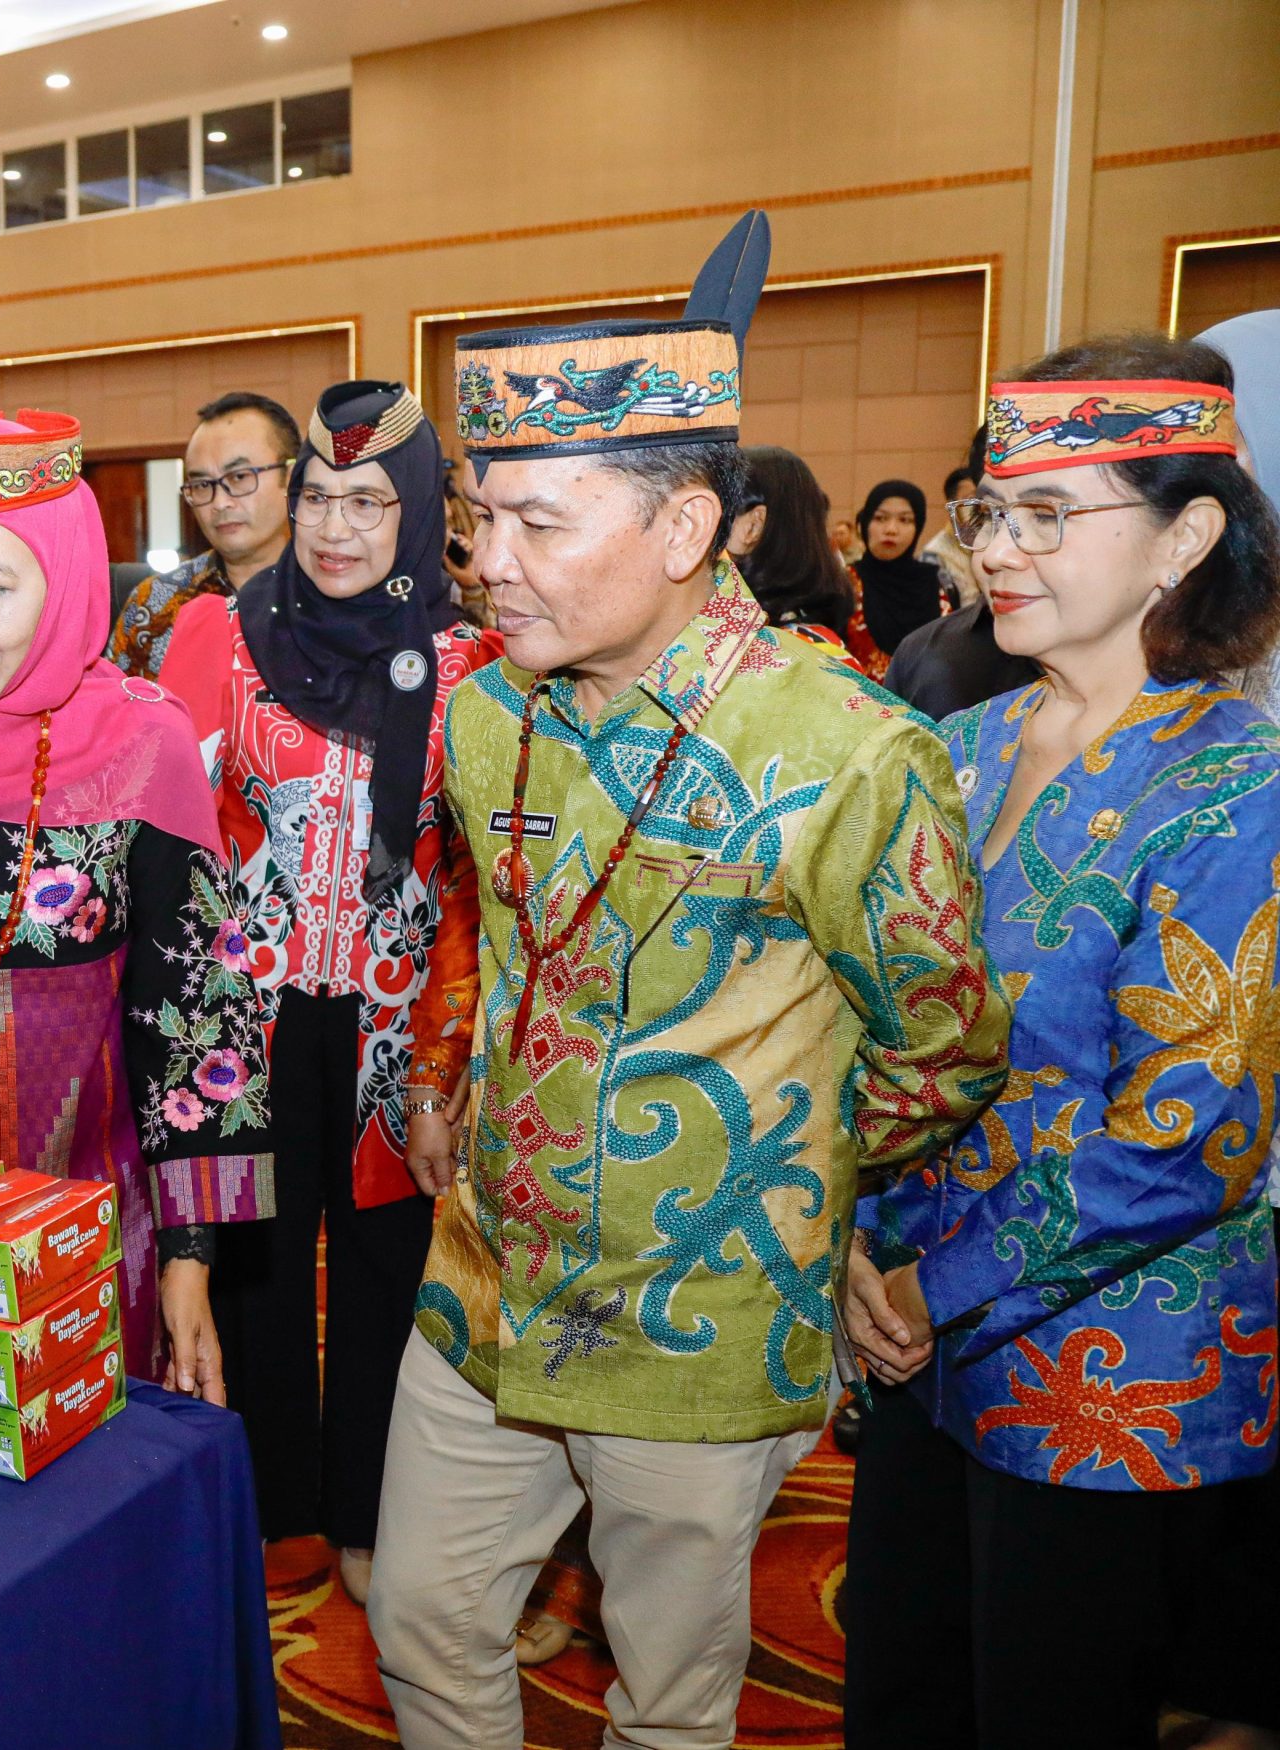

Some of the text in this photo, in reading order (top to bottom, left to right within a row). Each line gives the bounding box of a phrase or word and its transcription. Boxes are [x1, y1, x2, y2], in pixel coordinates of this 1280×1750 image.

[525, 820, 549, 831] SABRAN
[47, 1223, 79, 1248] Bawang
[57, 1233, 81, 1257] Dayak
[50, 1308, 81, 1334] Bawang
[57, 1319, 82, 1342] Dayak
[55, 1379, 85, 1405] Bawang
[63, 1389, 87, 1413] Dayak
